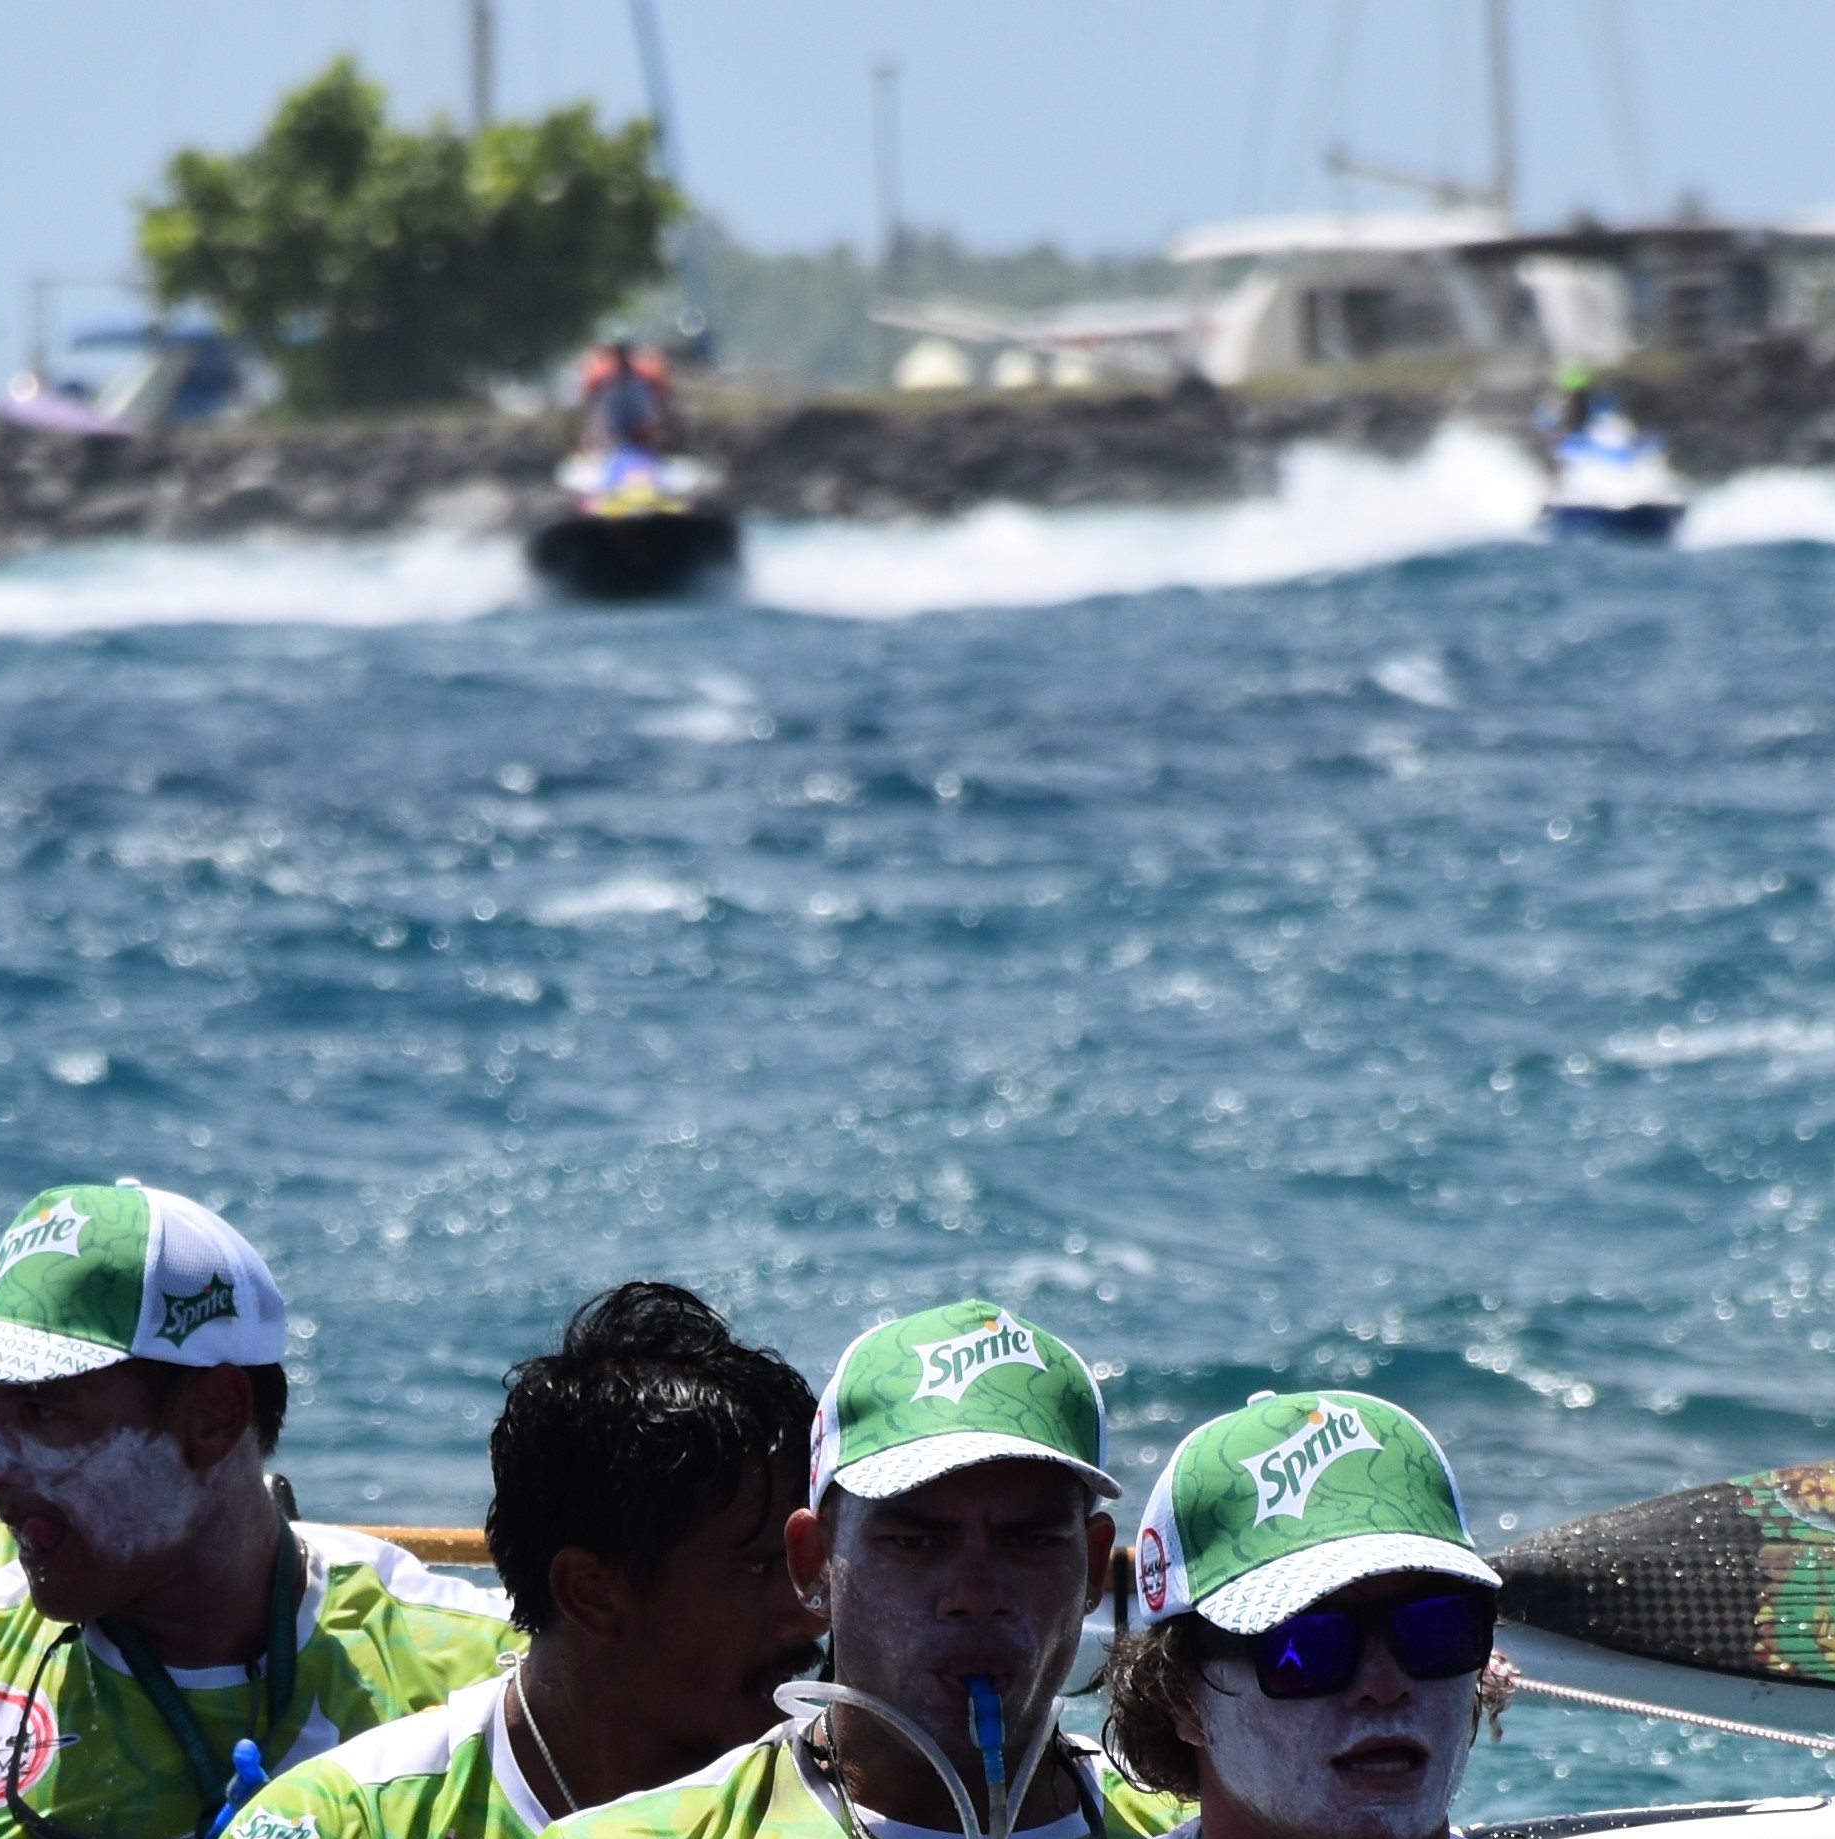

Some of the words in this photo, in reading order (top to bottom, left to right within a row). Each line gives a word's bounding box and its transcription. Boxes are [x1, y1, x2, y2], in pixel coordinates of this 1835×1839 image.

[165, 1285, 233, 1335] Sprite
[927, 1319, 1031, 1390] Sprite
[1262, 1410, 1361, 1510] Sprite
